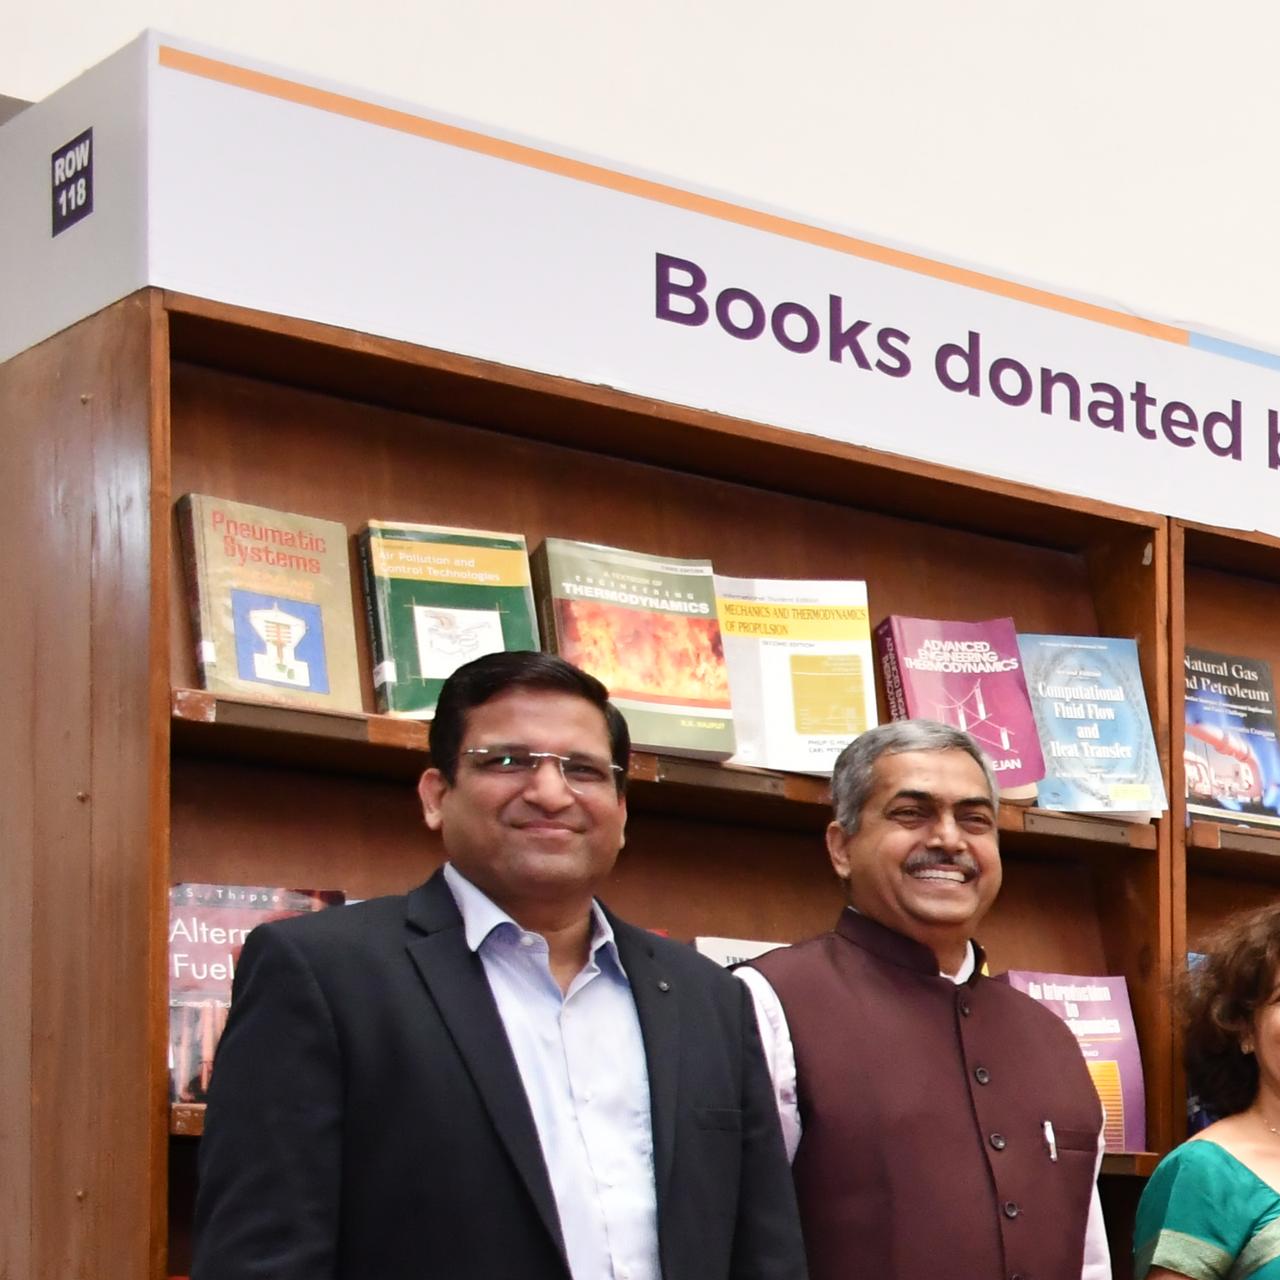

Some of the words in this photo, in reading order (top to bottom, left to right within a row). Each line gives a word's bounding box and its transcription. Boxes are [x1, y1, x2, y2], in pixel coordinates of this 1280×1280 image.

[55, 139, 90, 187] ROW
[58, 178, 87, 216] 118
[655, 252, 911, 378] Books
[935, 331, 1243, 460] donated
[211, 509, 327, 554] Pneumatic
[223, 534, 322, 576] Systems
[399, 552, 450, 566] Pollution
[454, 557, 475, 568] and
[427, 565, 501, 583] Technologies
[562, 582, 710, 615] THERMODYNAMICS
[724, 603, 771, 618] MECHANICS
[772, 607, 791, 619] AND
[792, 607, 867, 621] THERMODYNAMICS
[725, 621, 737, 632] OF
[738, 622, 789, 636] PROPULSION
[917, 648, 998, 663] ENGINEERING
[922, 640, 990, 654] ADVANCED
[904, 657, 1019, 674] THERMODYNAMICS
[1231, 664, 1259, 681] Gas
[1038, 681, 1125, 702] Computational
[1200, 677, 1270, 702] Petroleum
[1054, 702, 1085, 719] Fluid
[1087, 703, 1115, 720] Flow
[1076, 723, 1100, 739] and
[1050, 741, 1080, 758] Heat
[1080, 741, 1132, 758] Transfer
[990, 758, 1021, 771] EJAN
[1043, 982, 1112, 1001] Introduction
[1064, 1001, 1080, 1018] to
